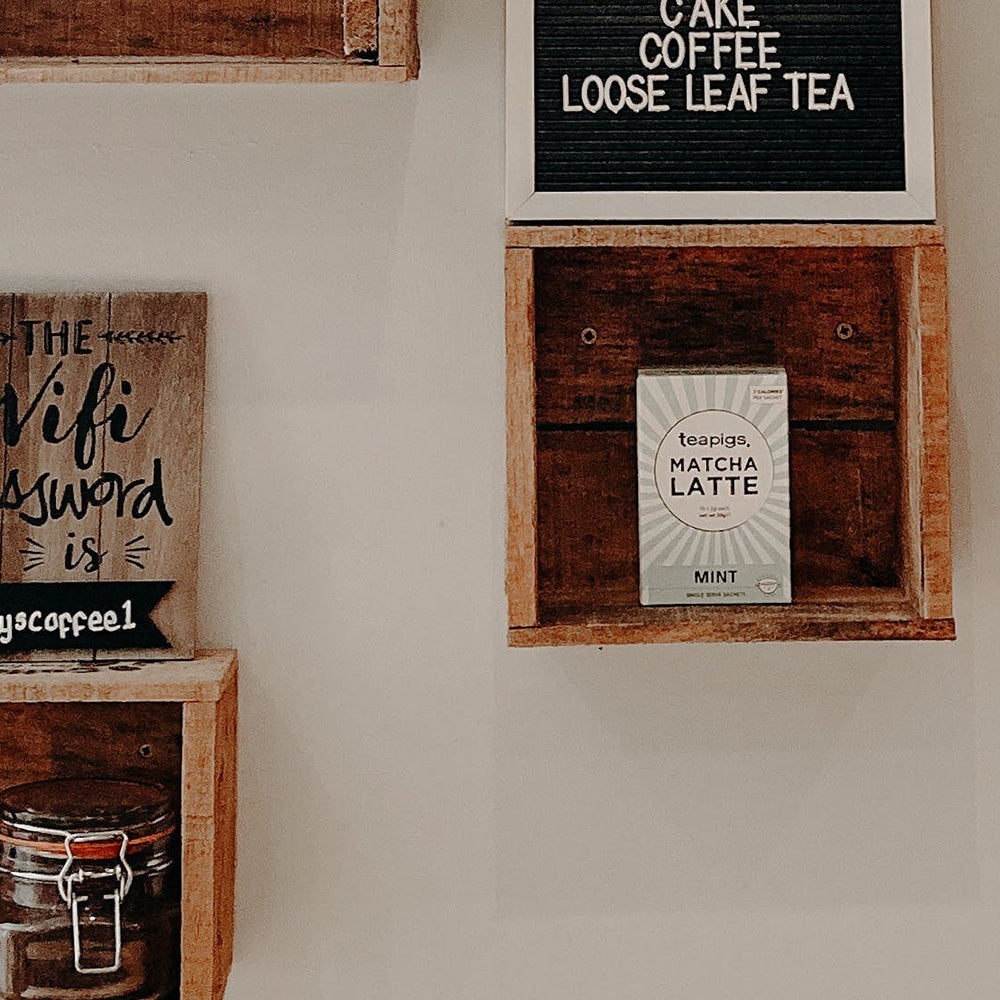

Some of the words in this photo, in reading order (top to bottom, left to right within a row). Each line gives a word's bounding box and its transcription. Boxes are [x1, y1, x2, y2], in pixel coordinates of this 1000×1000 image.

[638, 31, 781, 70] COFFEE
[562, 74, 670, 114] LOOSE
[685, 73, 772, 112] LEAF
[783, 71, 855, 111] TEA
[18, 320, 93, 356] THE
[678, 432, 751, 449] teapigs.
[670, 457, 758, 472] MATCHA
[670, 476, 758, 496] LATTE
[65, 532, 108, 573] is
[694, 571, 737, 583] MINT
